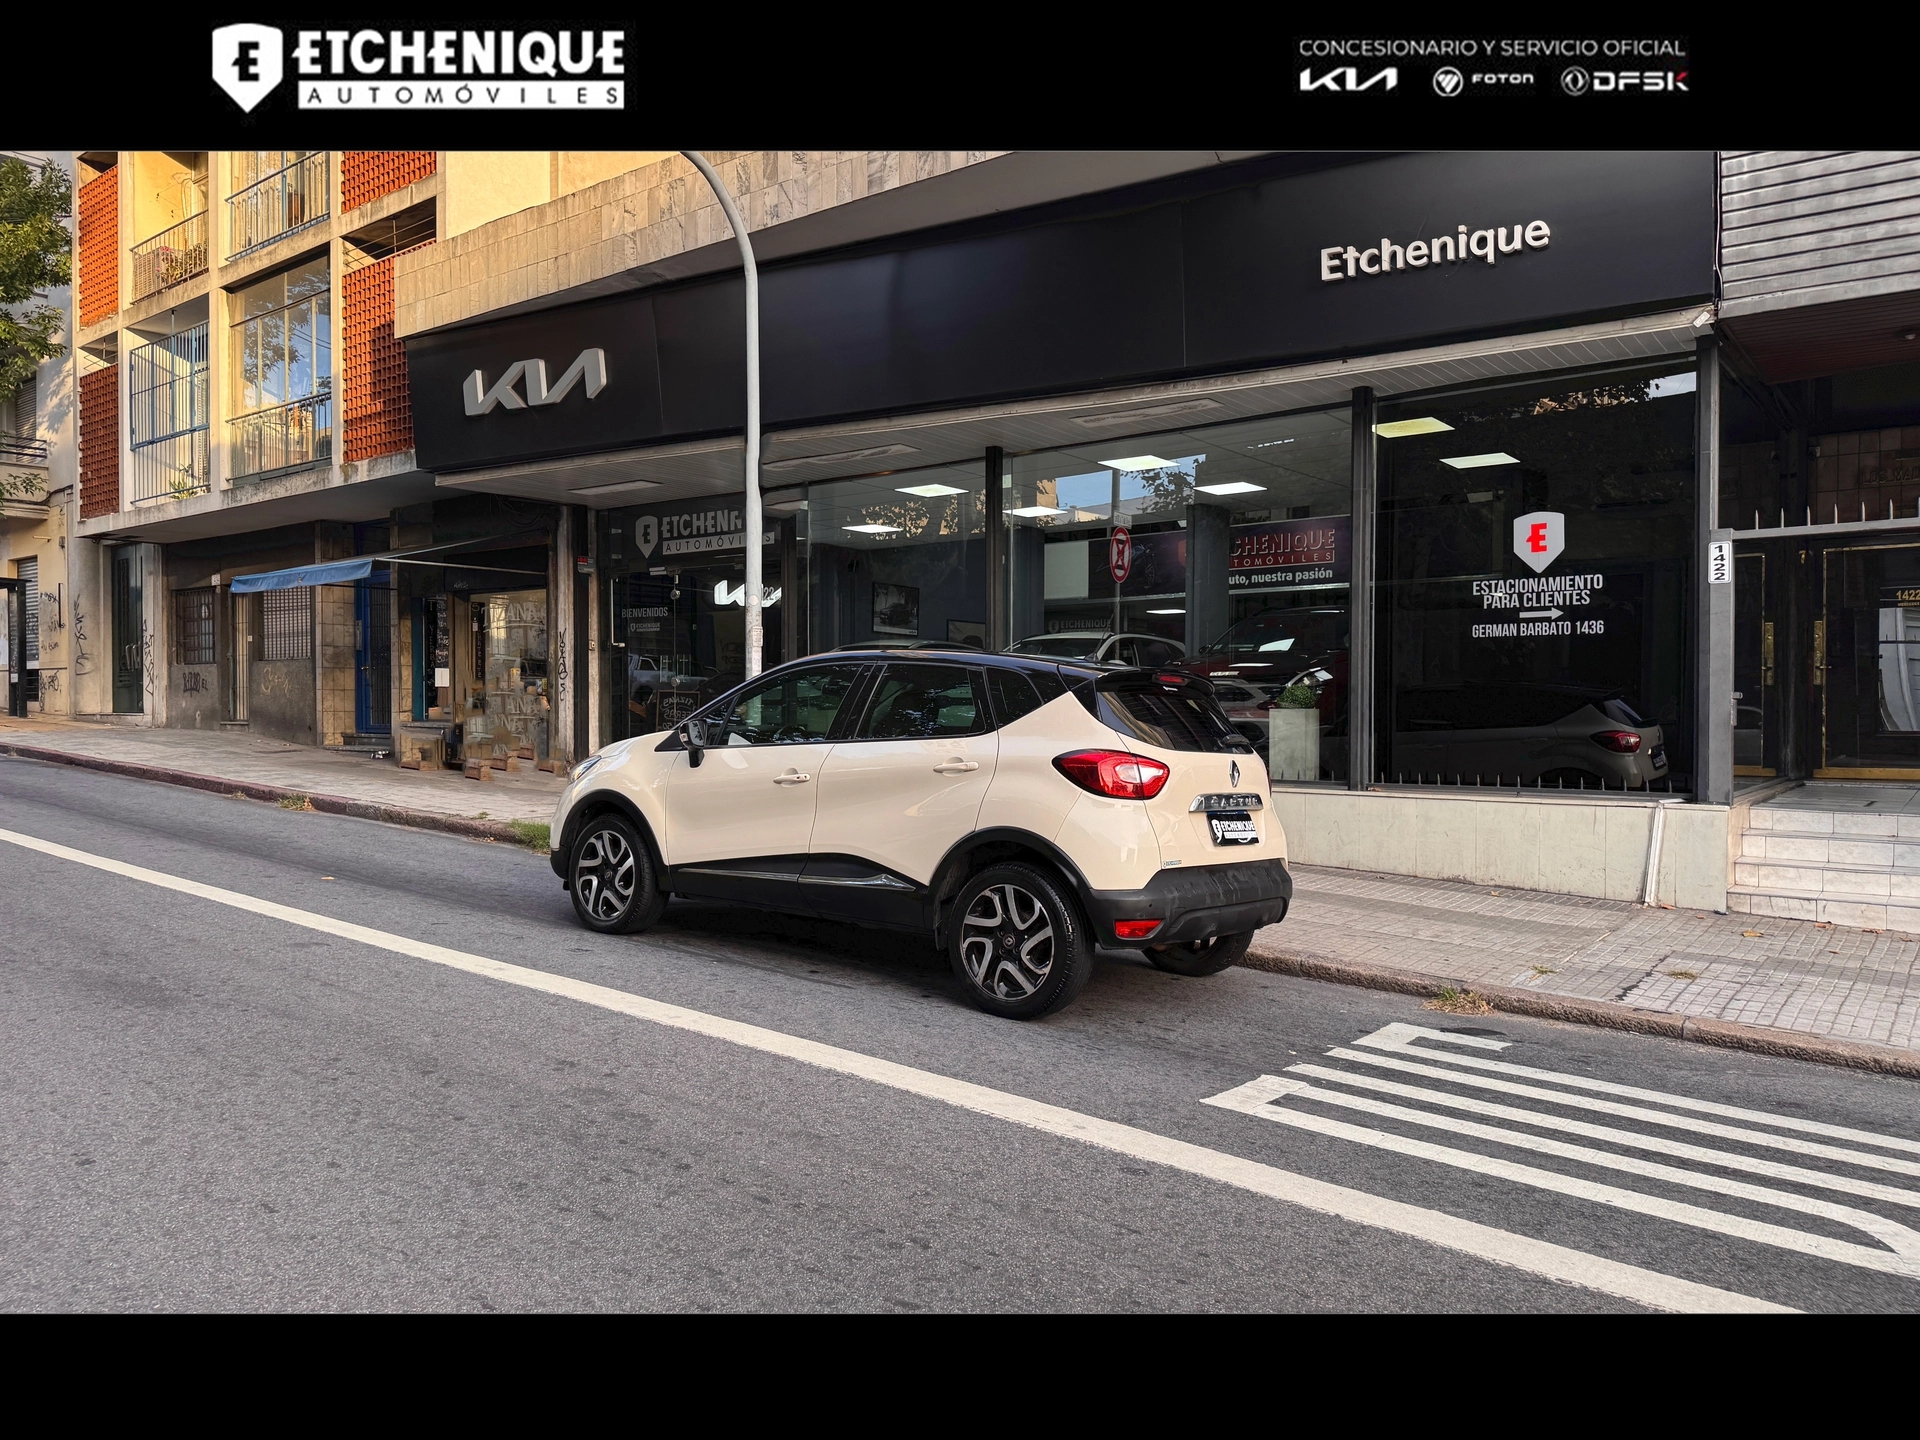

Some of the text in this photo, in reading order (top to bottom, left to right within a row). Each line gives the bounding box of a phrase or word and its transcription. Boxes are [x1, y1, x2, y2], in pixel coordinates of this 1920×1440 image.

[1320, 219, 1551, 282] Etchenique
[462, 347, 607, 416] KIA
[1229, 528, 1335, 556] CHENIQUE
[1233, 552, 1331, 567] TOMÓVILES
[1712, 544, 1726, 581] 1422
[1228, 567, 1333, 586] uto, nuestra pasión
[1472, 574, 1604, 596] ESTACIONAMIENTO
[1483, 589, 1591, 610] PARA CLIENTES
[1896, 589, 1920, 601] 1422
[621, 606, 669, 618] BIENVENIDOS
[1472, 620, 1605, 638] GERMAN BARBATO 1436
